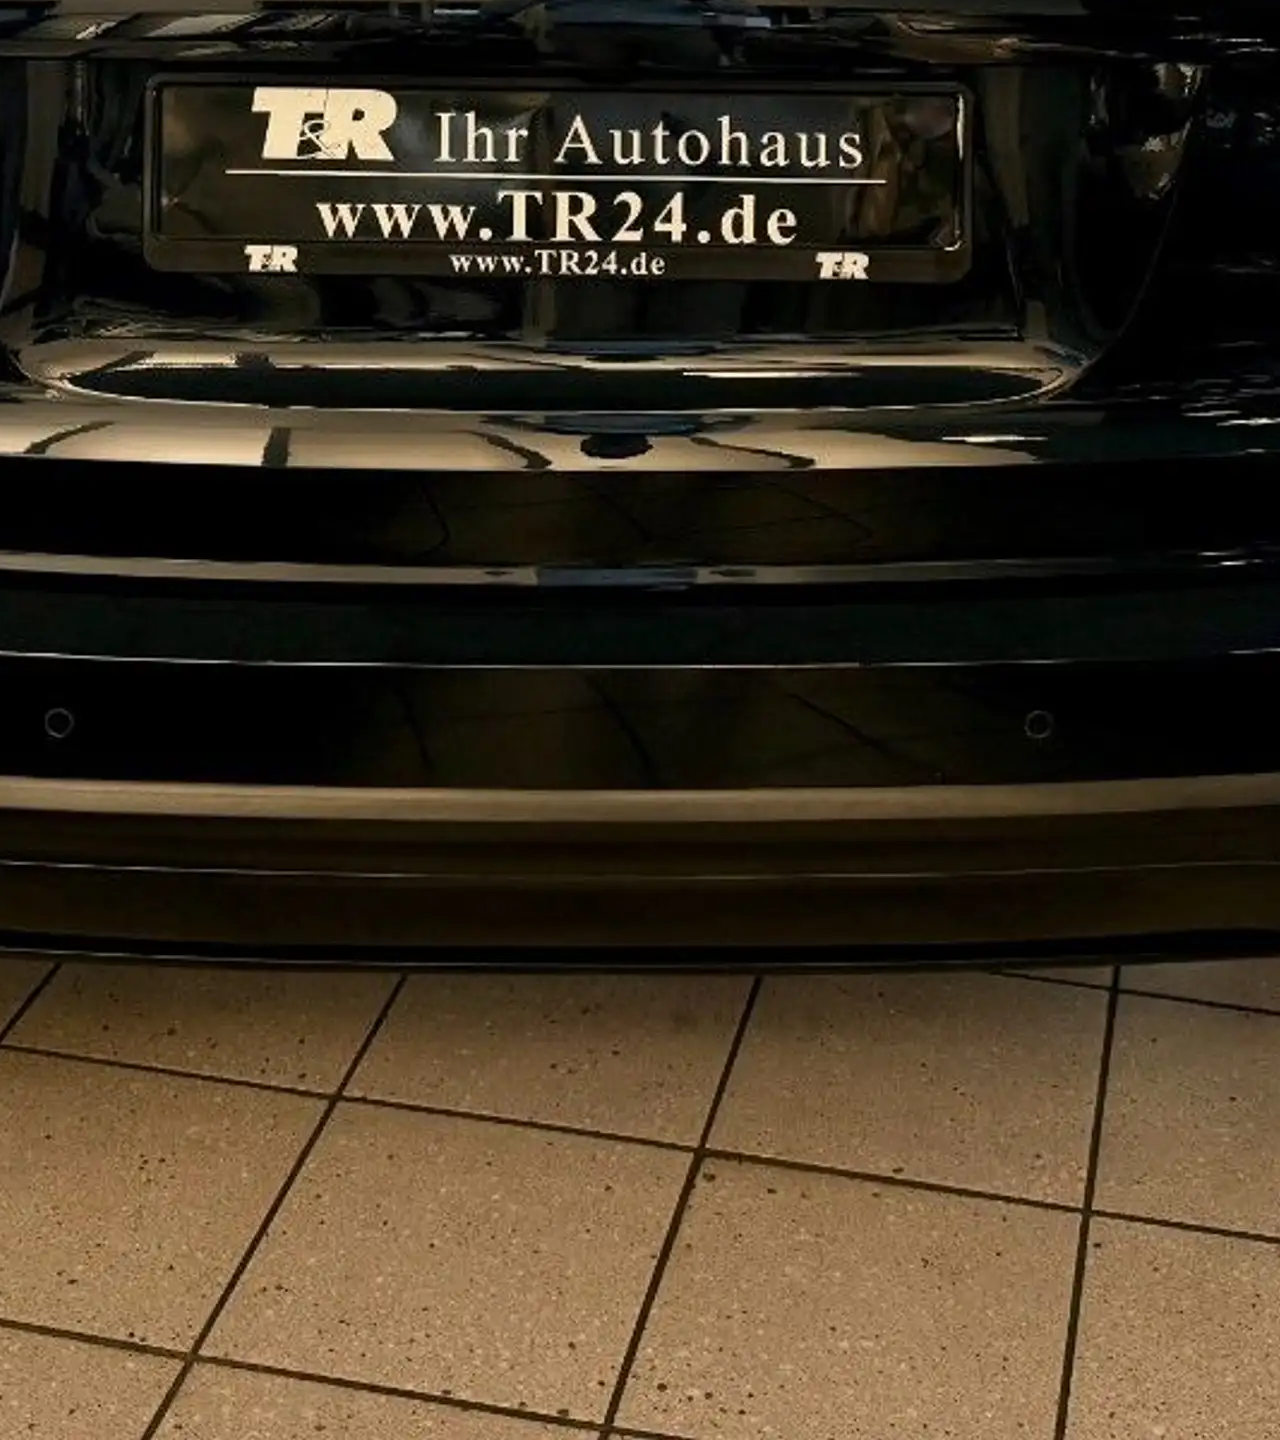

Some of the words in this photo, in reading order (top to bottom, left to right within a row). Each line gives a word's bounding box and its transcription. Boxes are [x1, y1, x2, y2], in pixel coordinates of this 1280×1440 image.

[433, 110, 529, 163] Ihr
[554, 113, 864, 169] Autohaus
[316, 189, 799, 247] www.TR24.de
[449, 248, 667, 277] www.TR24.de
